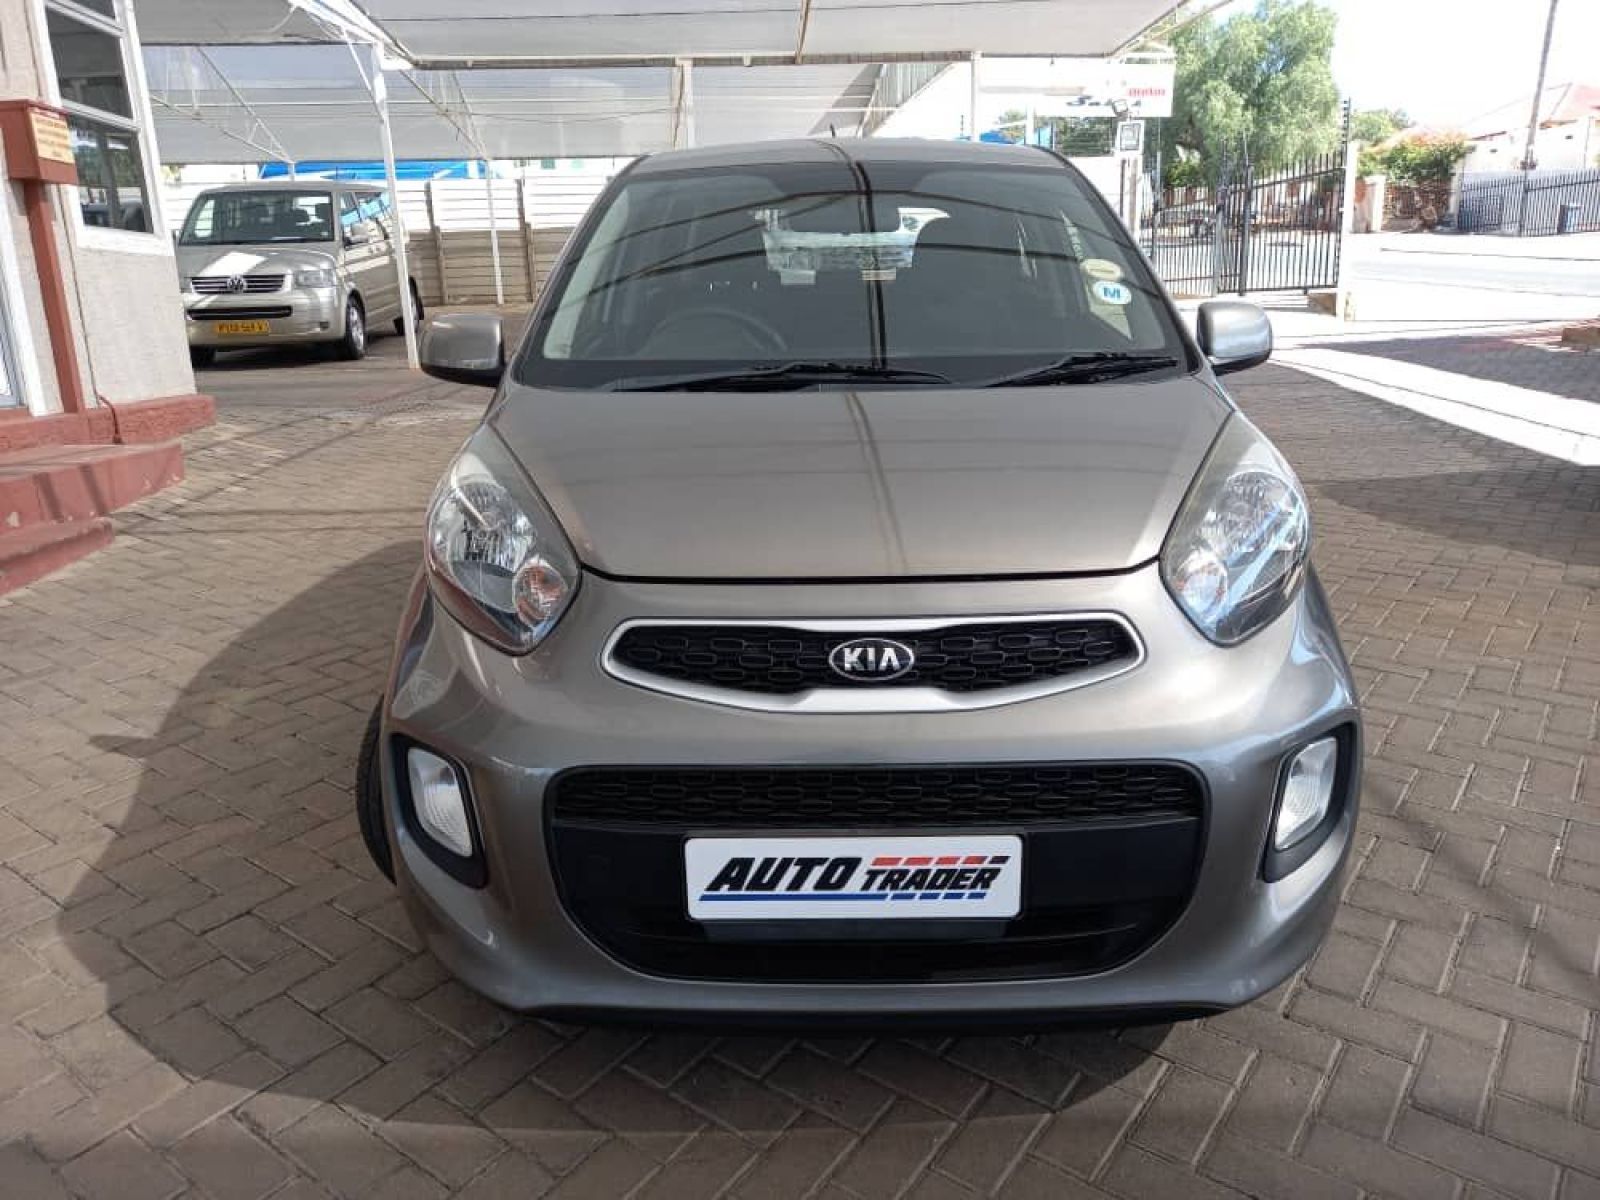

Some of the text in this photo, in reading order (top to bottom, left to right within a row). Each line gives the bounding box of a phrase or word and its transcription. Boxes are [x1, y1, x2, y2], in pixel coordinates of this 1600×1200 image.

[843, 647, 900, 671] KIA
[704, 857, 1001, 892] AUTO TRADER
